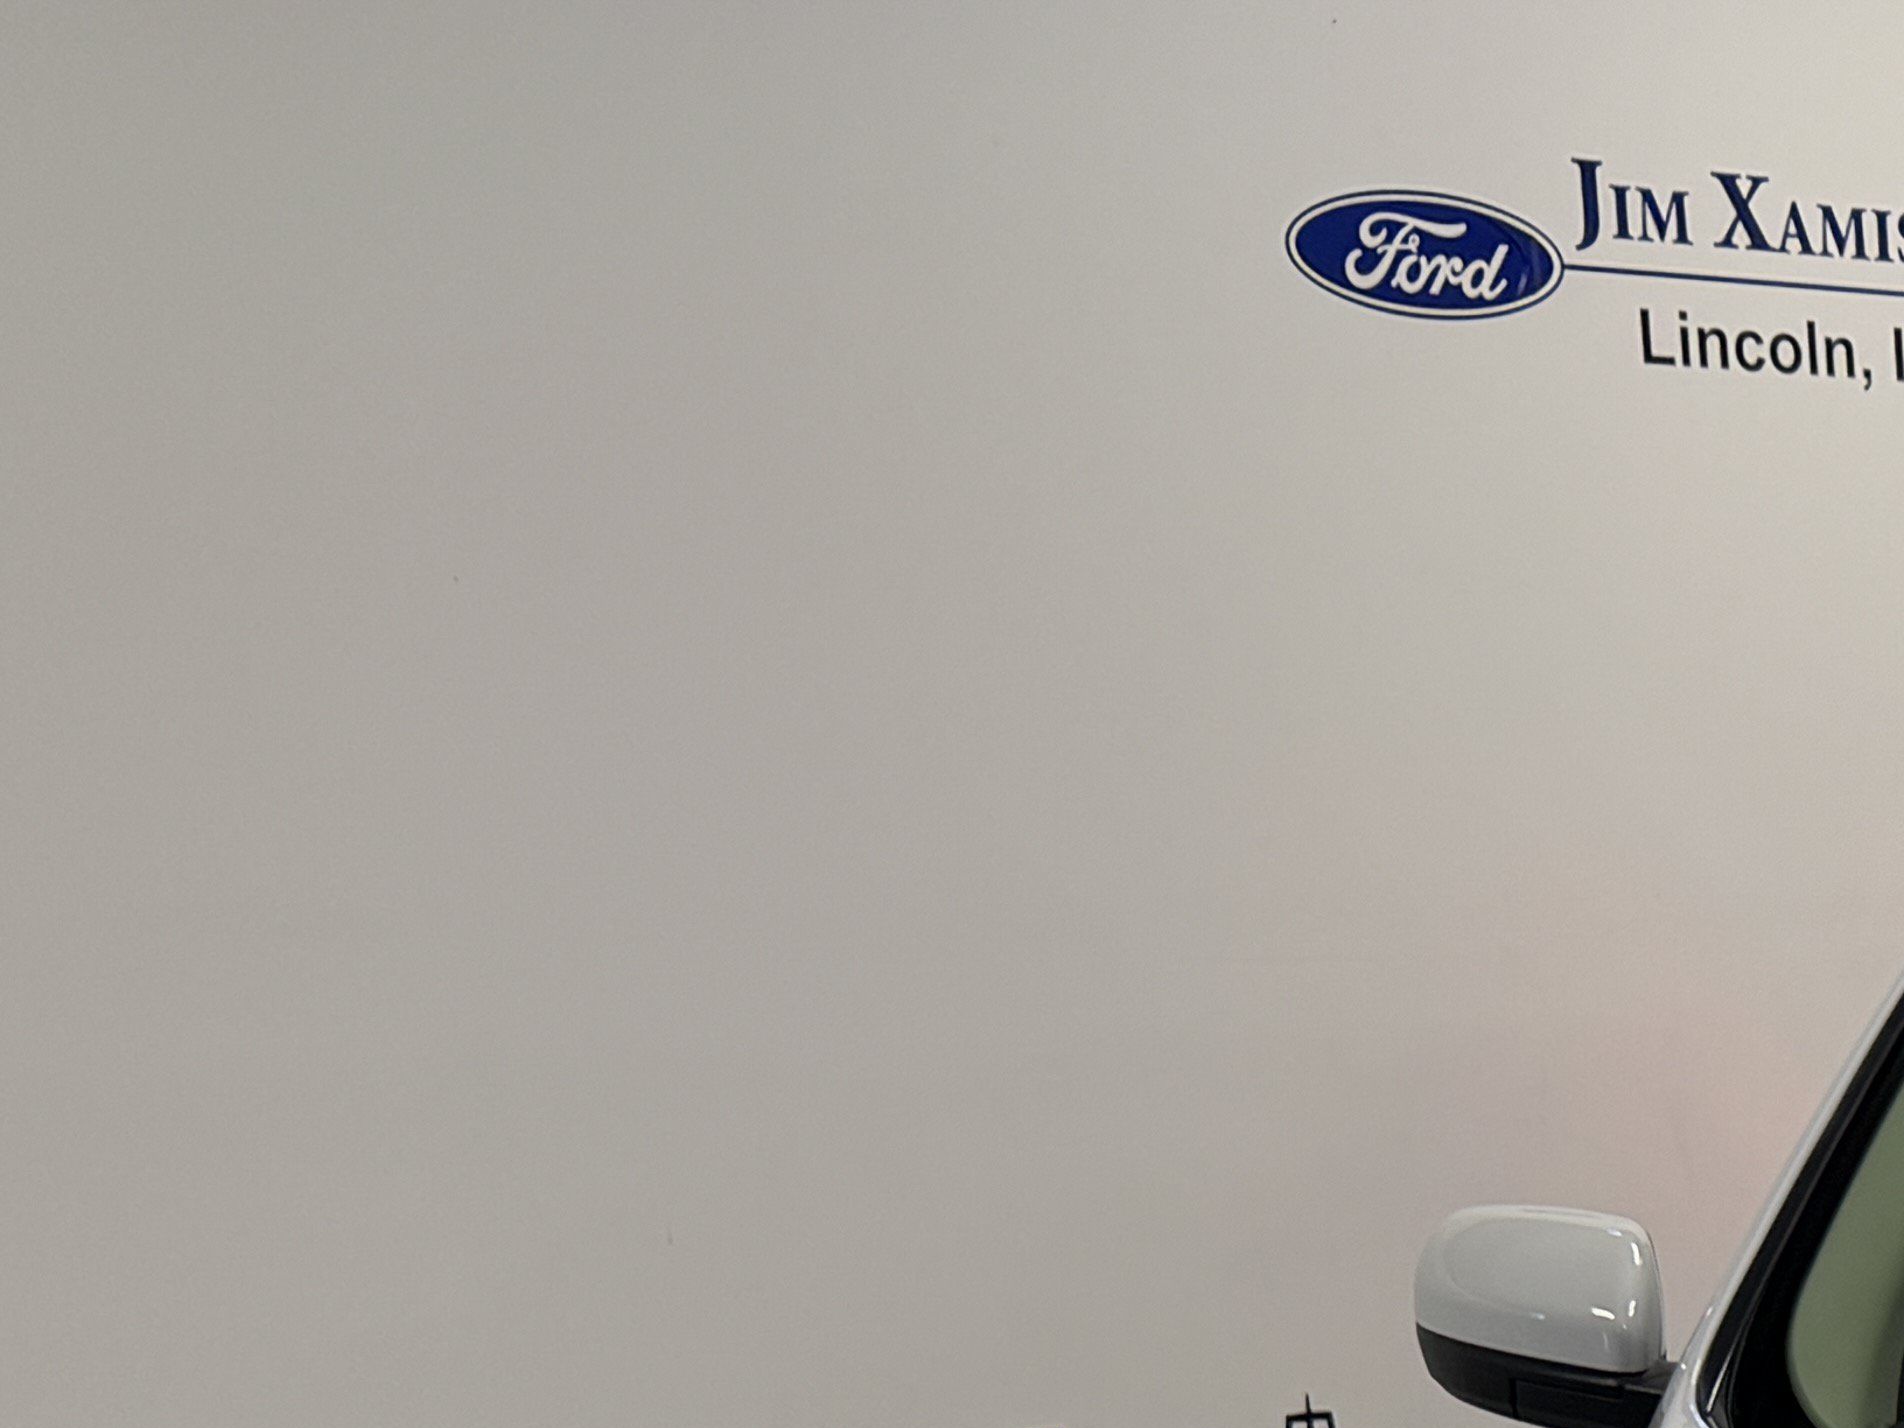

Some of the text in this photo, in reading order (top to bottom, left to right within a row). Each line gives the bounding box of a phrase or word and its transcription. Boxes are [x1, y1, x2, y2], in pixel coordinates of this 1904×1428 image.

[1571, 157, 1693, 252] JIM
[1344, 212, 1508, 301] Ford
[1640, 308, 1873, 390] Lincoln,
